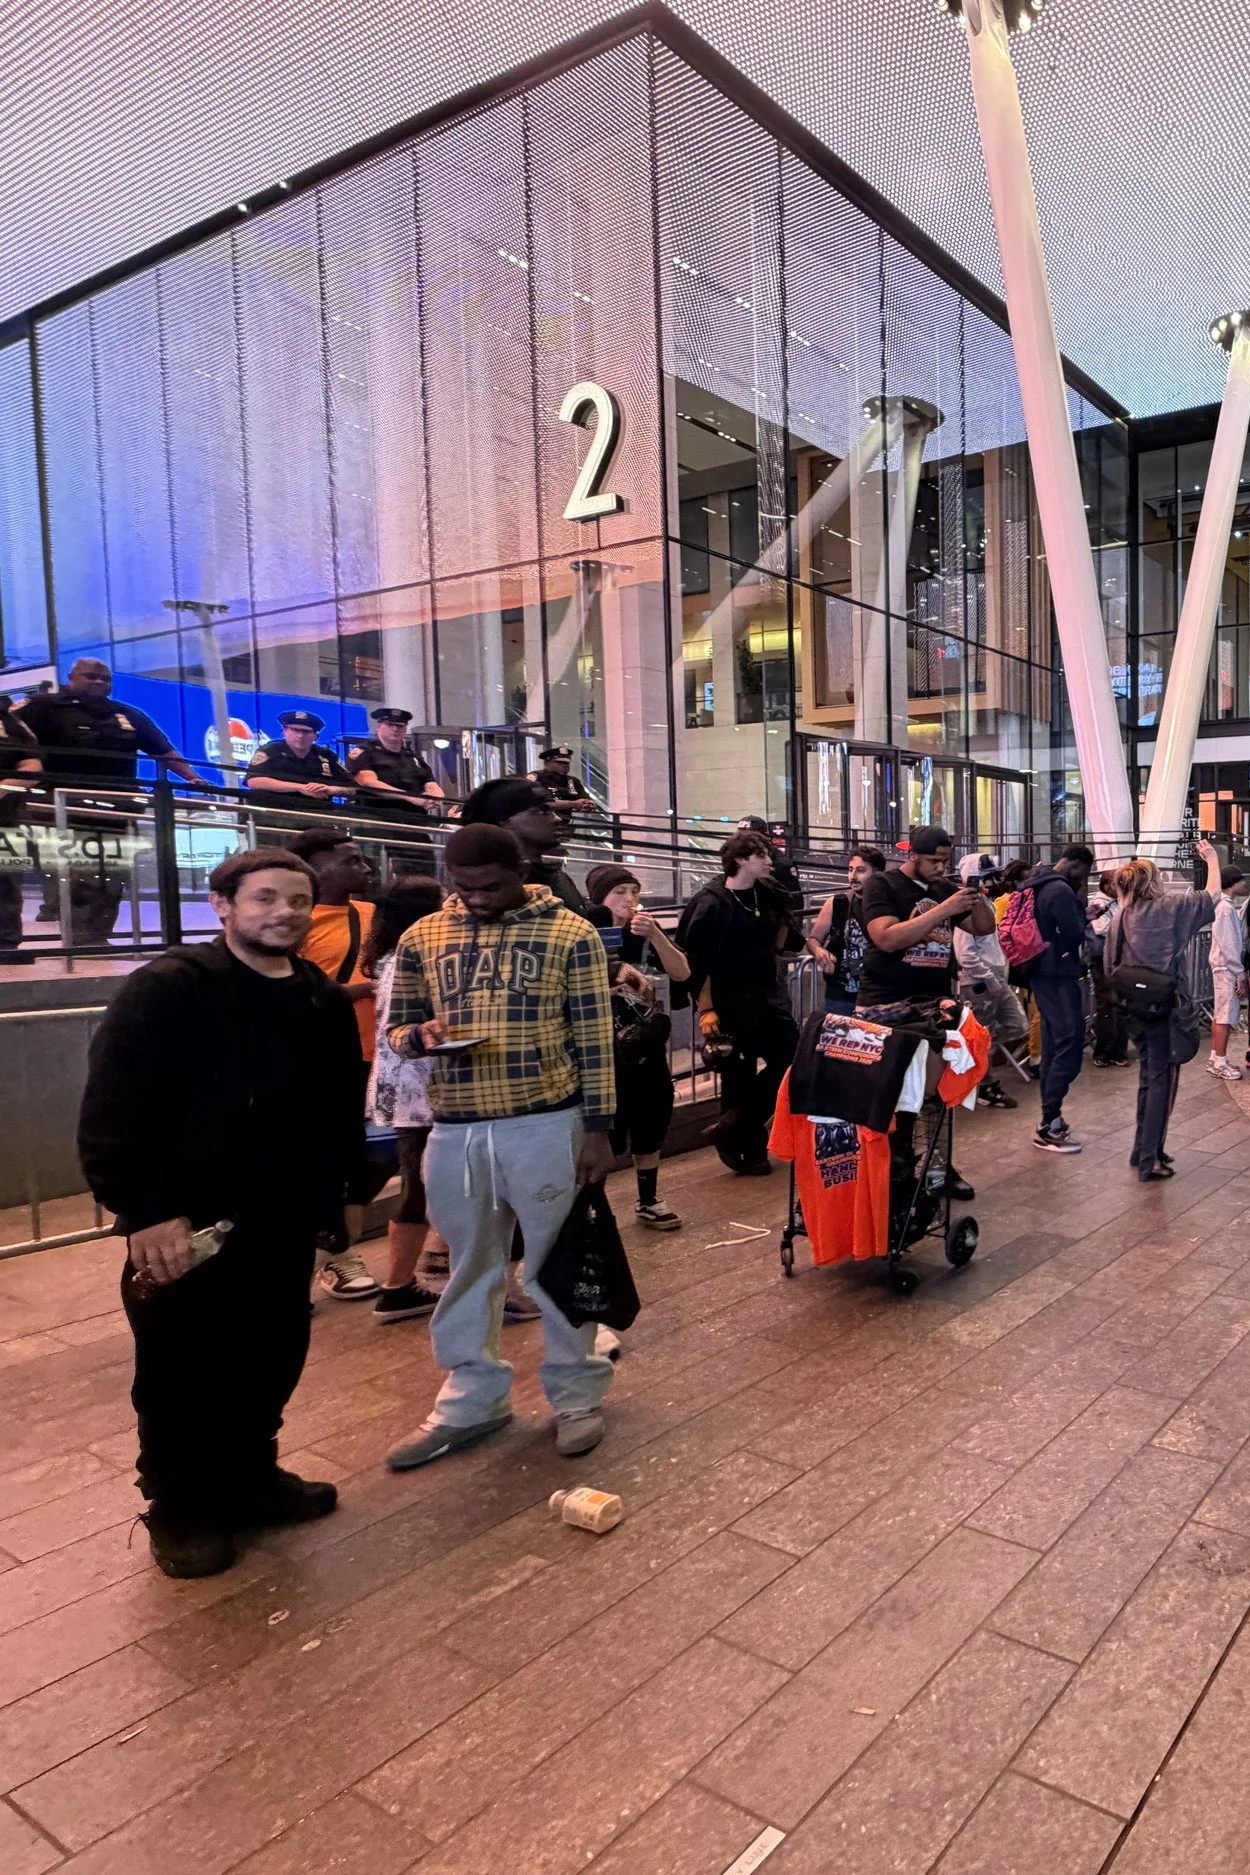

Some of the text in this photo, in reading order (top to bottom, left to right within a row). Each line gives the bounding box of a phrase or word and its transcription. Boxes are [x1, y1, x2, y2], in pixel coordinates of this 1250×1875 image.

[558, 381, 622, 521] 2
[821, 1034, 884, 1054] WE REP NYC
